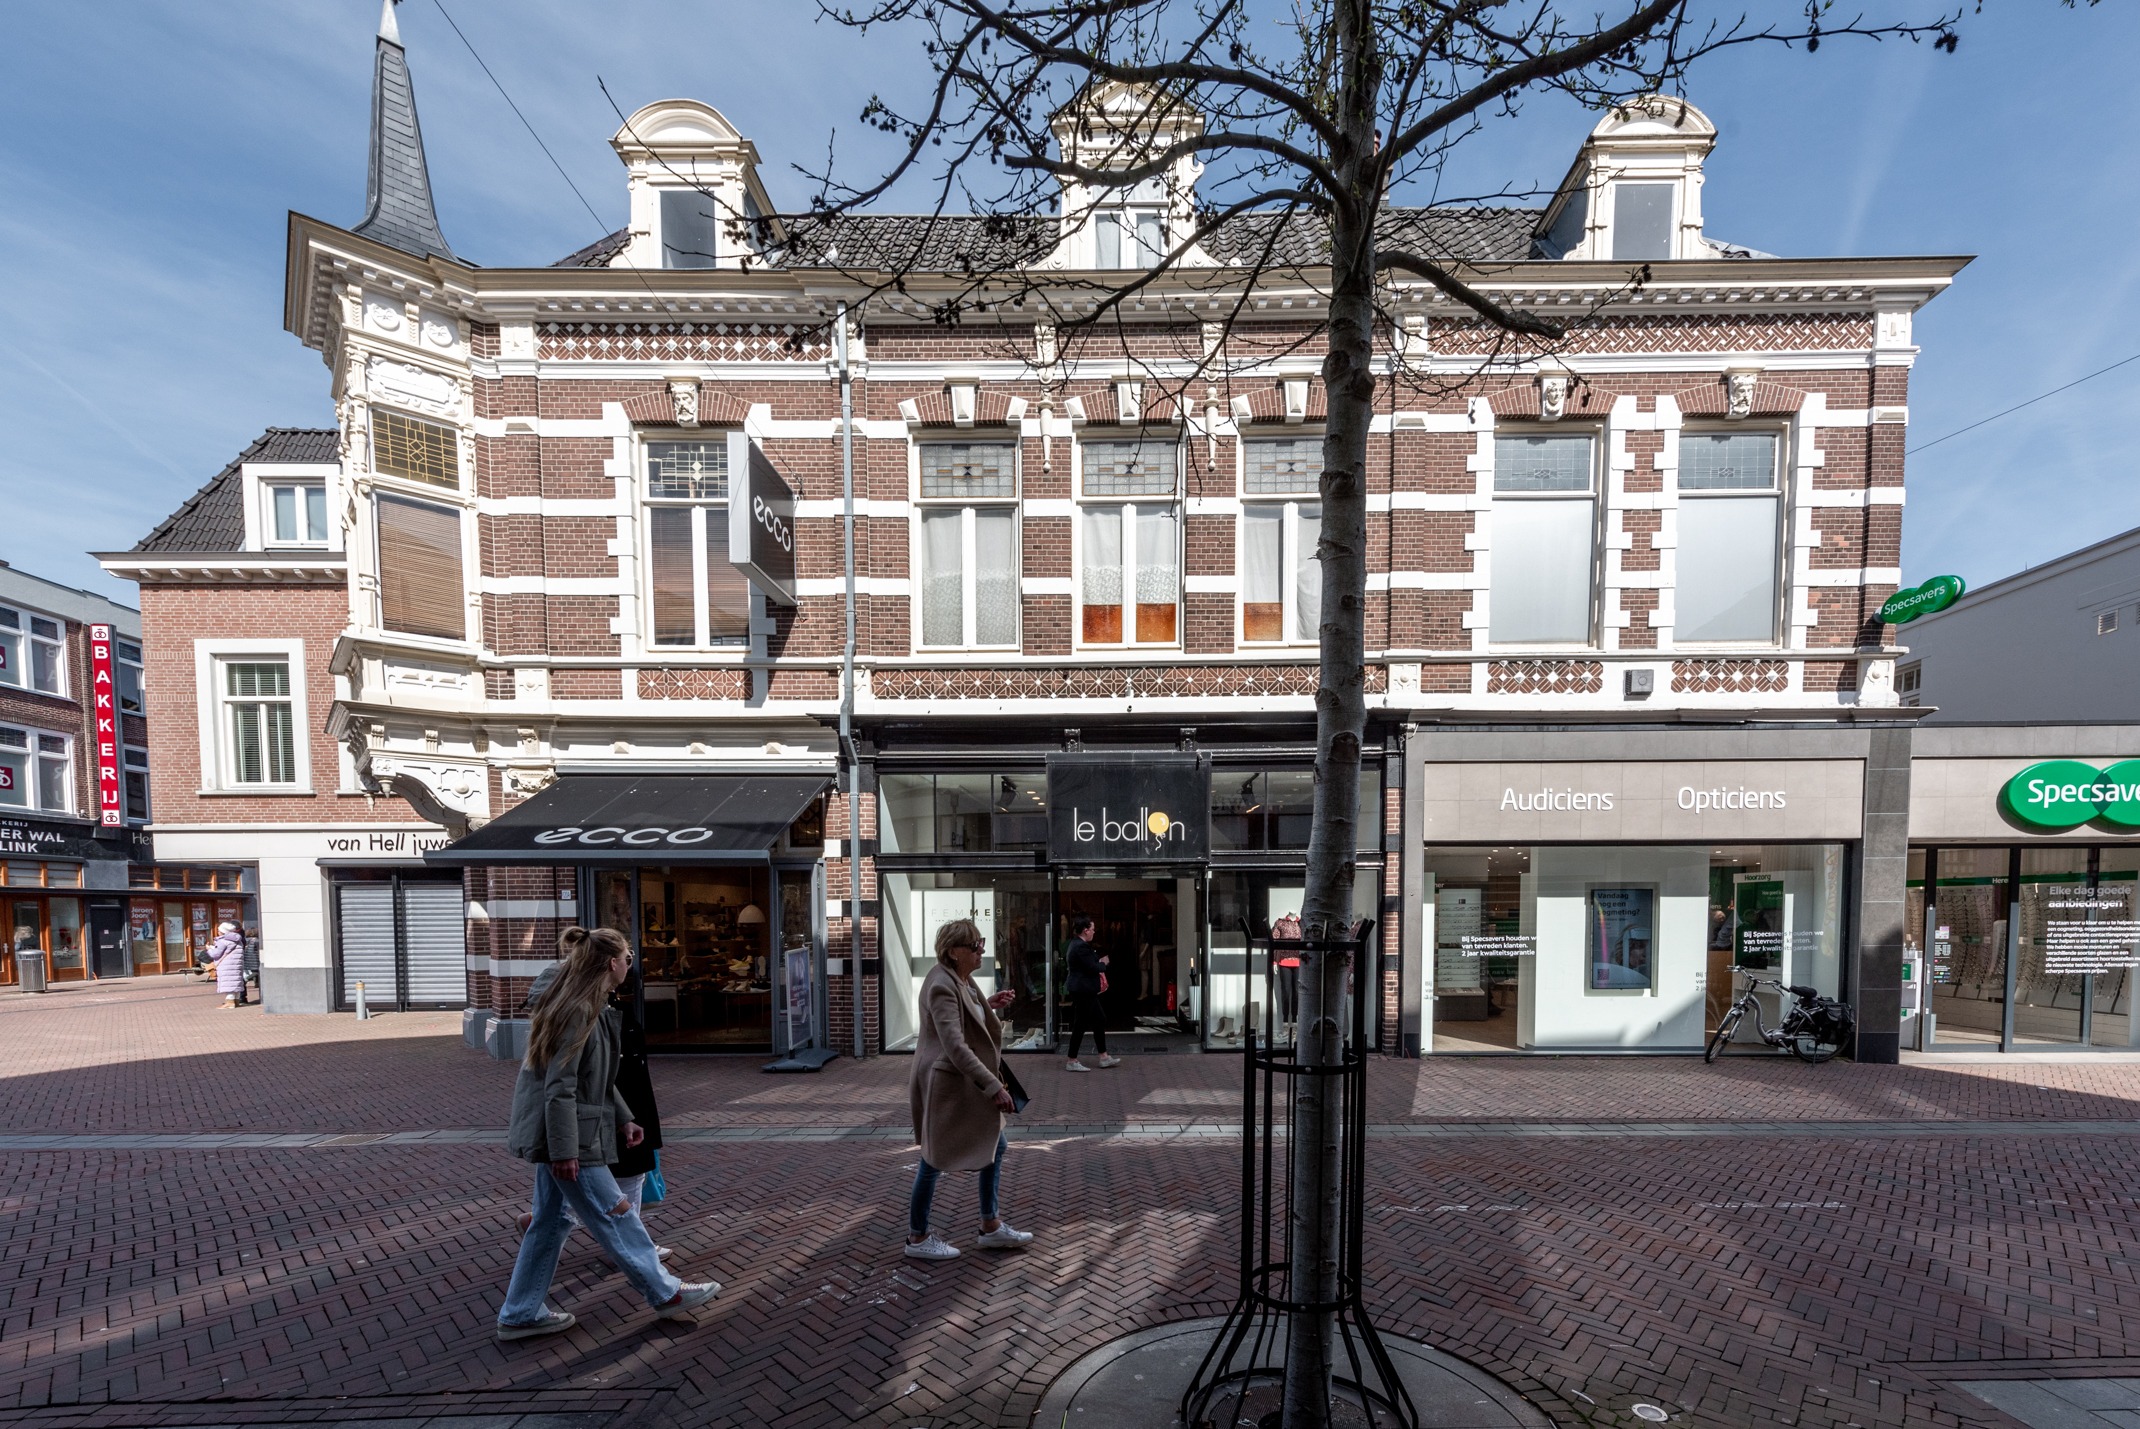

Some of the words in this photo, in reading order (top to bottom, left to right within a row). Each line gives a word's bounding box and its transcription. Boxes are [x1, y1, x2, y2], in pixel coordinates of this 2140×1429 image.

[753, 495, 792, 552] ecco
[1884, 585, 1946, 616] Specsavers
[94, 645, 119, 804] BAKKERIJ
[1500, 787, 1614, 812] Audiciens
[1677, 786, 1787, 814] Opticiens
[28, 830, 65, 843] WAL
[533, 827, 714, 844] ecco
[1074, 807, 1095, 842] le
[327, 838, 361, 851] van
[369, 833, 405, 851] Hell
[2048, 898, 2123, 909] aanbiedingen
[2049, 886, 2072, 895] Elke
[2073, 885, 2095, 897] dag
[2096, 885, 2132, 896] goede
